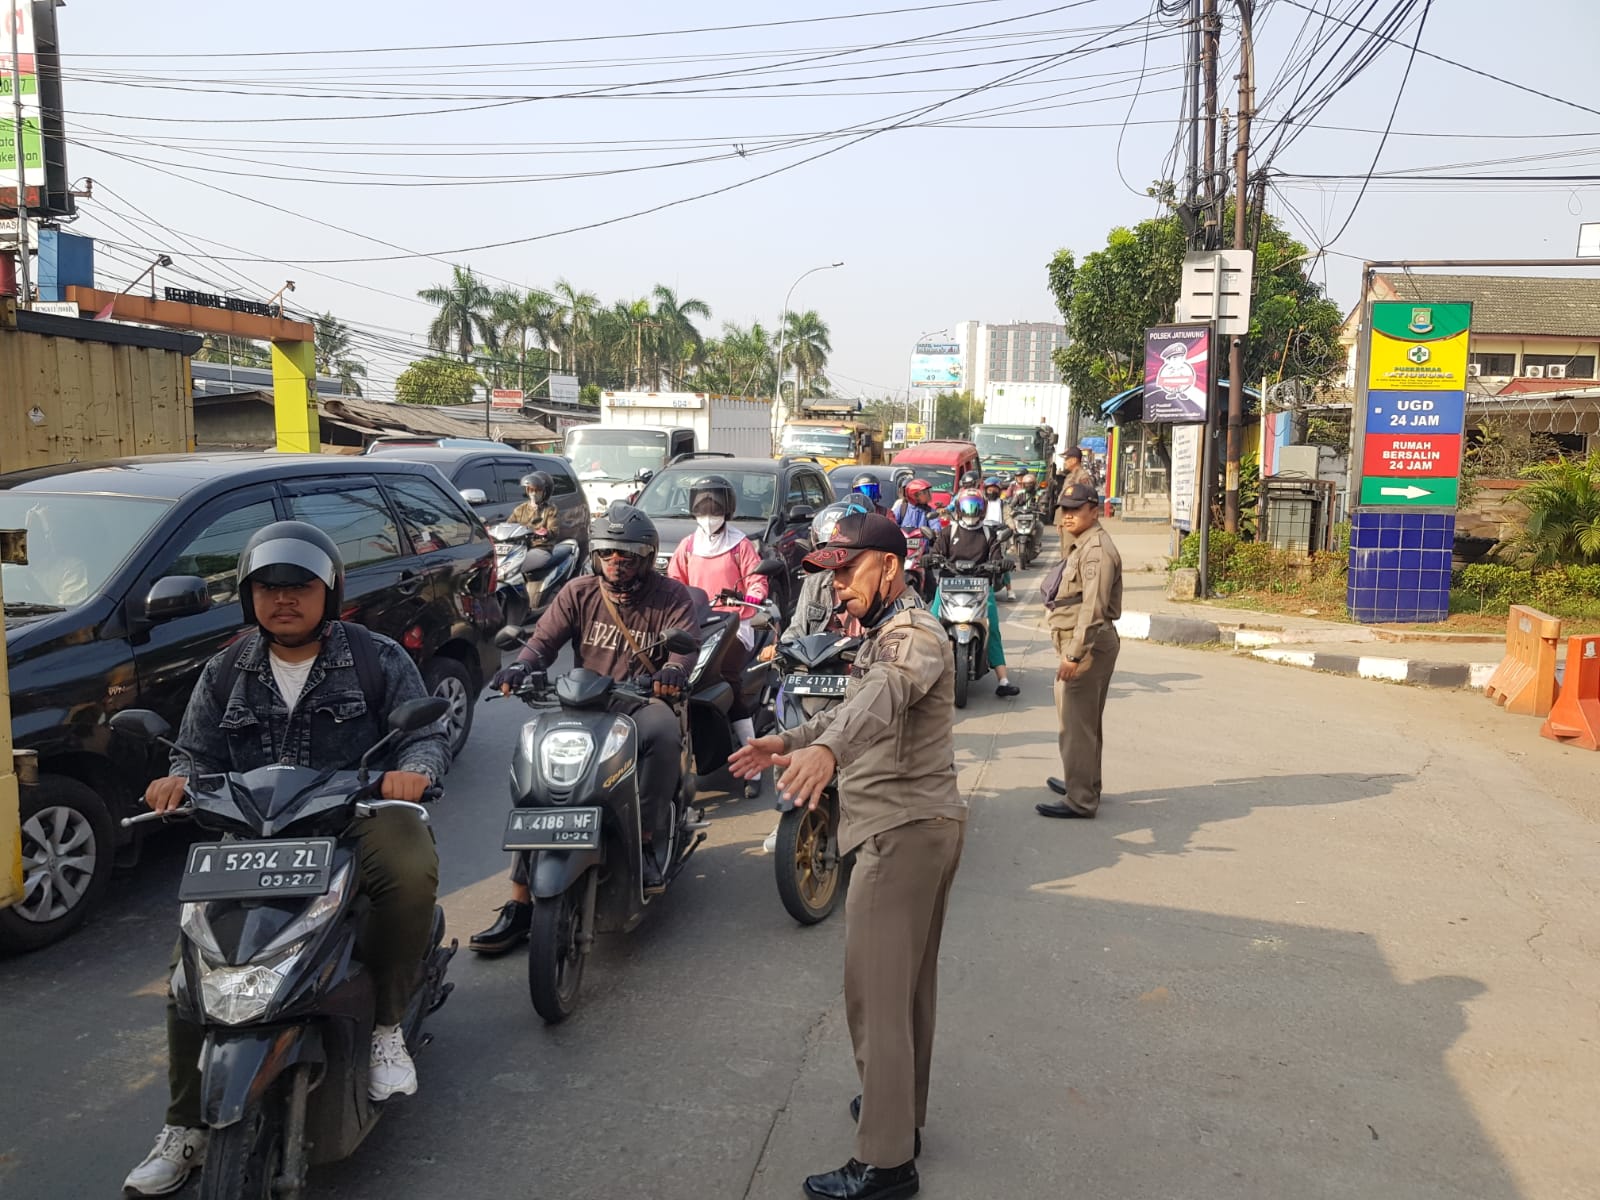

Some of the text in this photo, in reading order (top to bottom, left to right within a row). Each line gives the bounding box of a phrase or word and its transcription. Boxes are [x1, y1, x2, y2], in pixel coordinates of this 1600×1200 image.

[1149, 331, 1205, 340] POLSEK JATIUWUNG
[1397, 400, 1434, 411] UGD
[1390, 414, 1440, 426] 24 JAM
[1392, 441, 1432, 450] RUMAH
[1382, 450, 1440, 460] BERSALIN
[1389, 460, 1433, 470] 24 JAM
[788, 675, 803, 685] BE
[806, 676, 833, 686] 4171
[513, 816, 523, 830] A
[532, 815, 565, 830] 4186
[199, 850, 317, 872] A 5234 ZL
